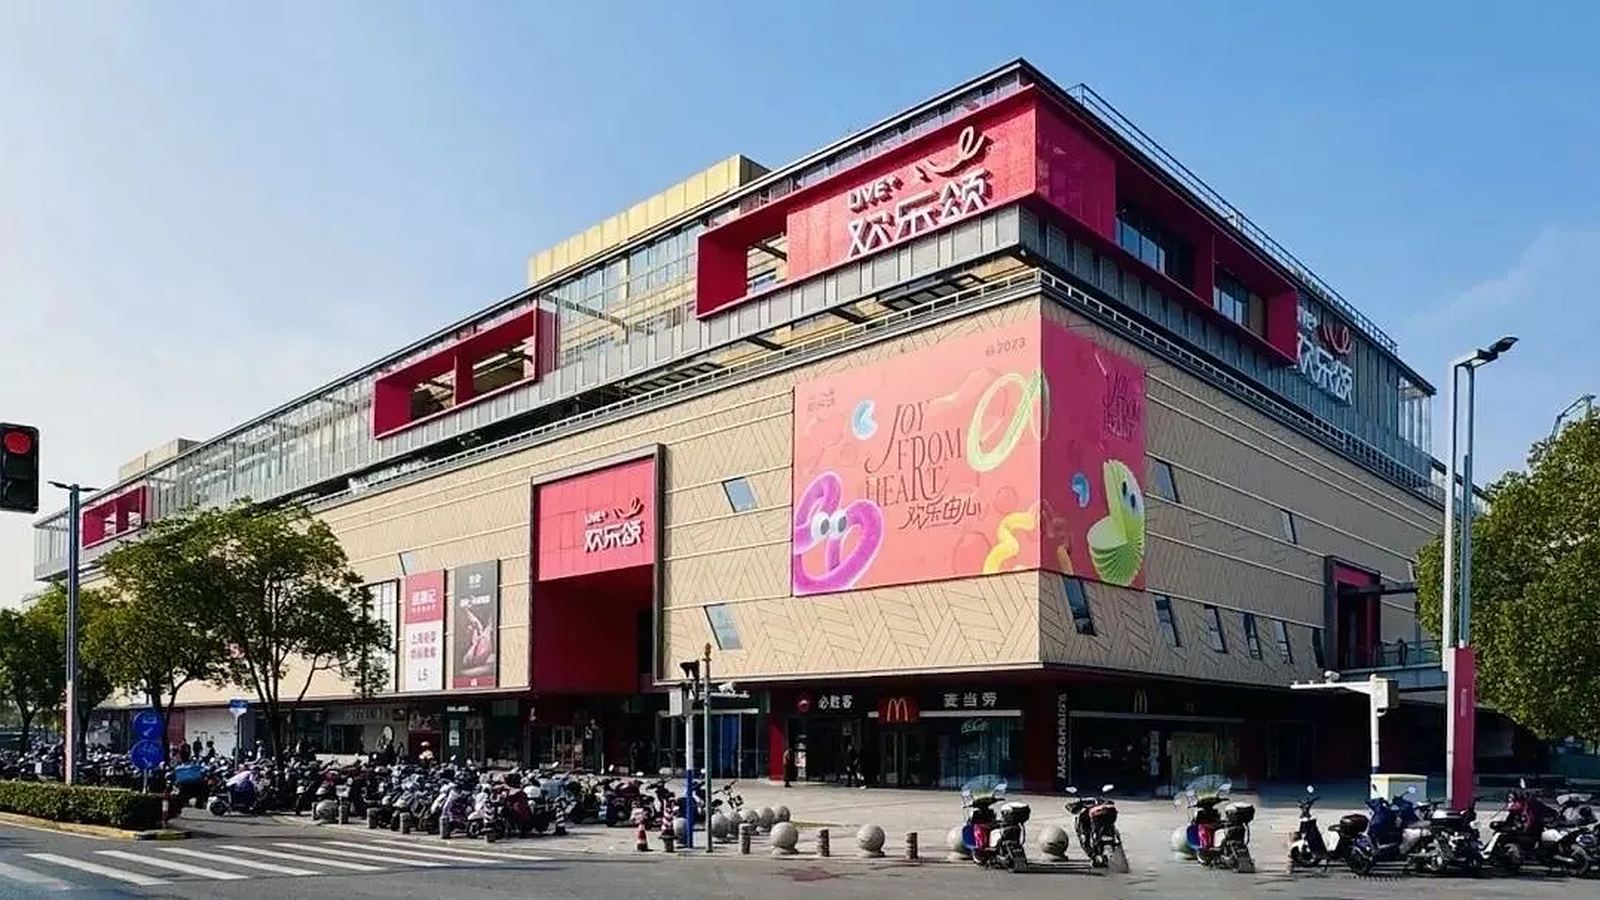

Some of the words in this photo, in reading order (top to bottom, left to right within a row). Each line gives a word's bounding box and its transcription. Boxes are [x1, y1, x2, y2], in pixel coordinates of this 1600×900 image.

[848, 168, 992, 258] 欢乐颂
[864, 401, 931, 474] JOY
[897, 428, 962, 480] FROM
[866, 466, 948, 507] HEART
[898, 496, 982, 530] 欢乐由心
[584, 519, 643, 552] 欢乐颂
[818, 694, 854, 711] 必胜客
[944, 692, 998, 708] 麦当劳
